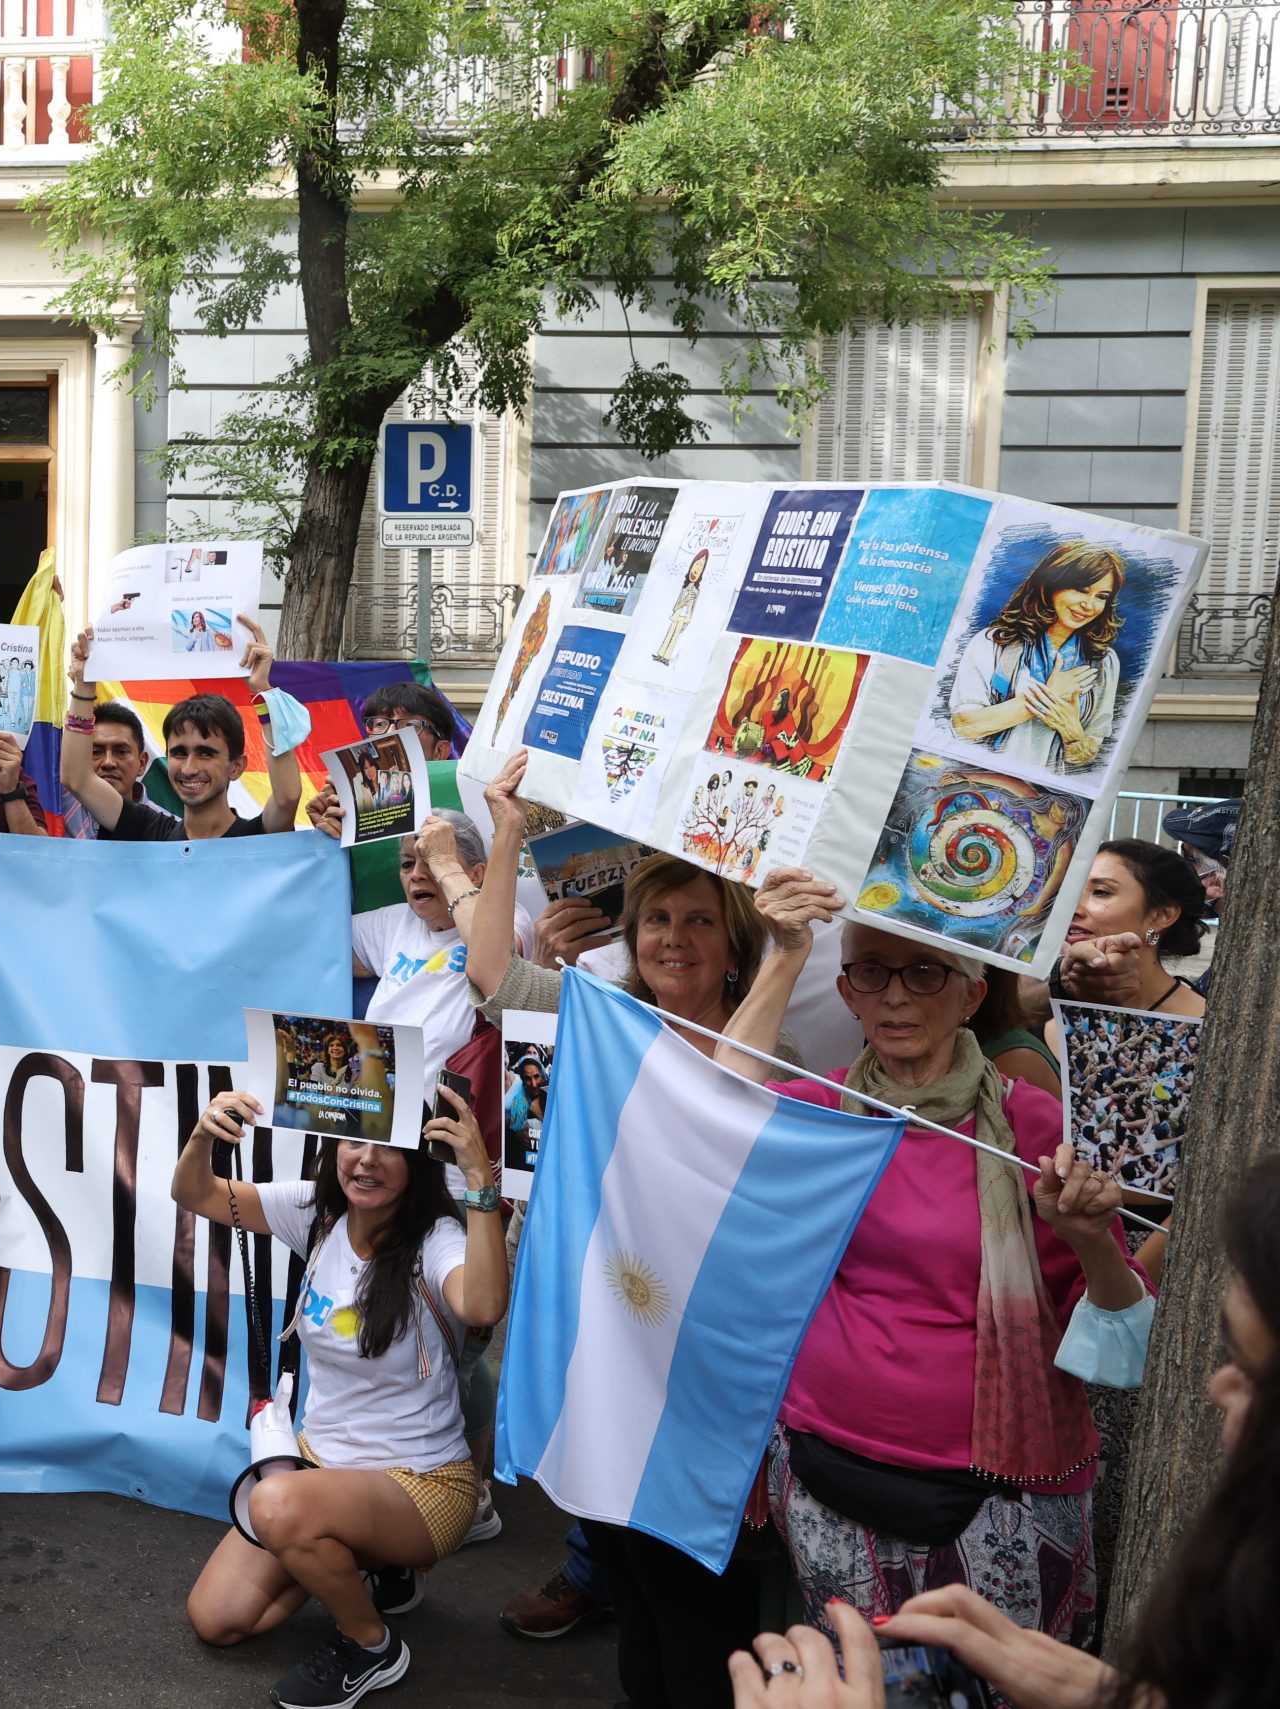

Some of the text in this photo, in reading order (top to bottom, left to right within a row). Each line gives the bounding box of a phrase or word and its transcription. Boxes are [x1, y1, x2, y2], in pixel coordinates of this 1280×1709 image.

[408, 431, 446, 504] P
[428, 484, 462, 497] C.D.
[646, 502, 660, 518] LA
[614, 518, 664, 538] VIOLENCIA
[771, 511, 842, 536] TODOS CON
[438, 533, 470, 541] ARGENTINA
[629, 537, 658, 553] DECIMOS
[761, 538, 830, 569] CRISTINA
[858, 540, 871, 550] Por
[872, 540, 880, 550] la
[880, 541, 893, 552] Paz
[902, 542, 950, 561] Defensa
[859, 556, 933, 575] de la Democracia
[610, 571, 635, 592] MÁS
[791, 576, 817, 584] democracia
[854, 581, 919, 599] Viernes 02/09
[846, 594, 861, 604] Colón
[895, 600, 920, 614] 18hs.
[555, 649, 601, 670] REPUDIO
[540, 689, 585, 710] CRISTINA
[613, 706, 665, 729] AMERICA
[611, 721, 656, 743] LATINA
[561, 862, 628, 898] FUERZA
[287, 1078, 383, 1099] El pueblo no olvida.
[288, 1091, 380, 1112] #TodosConCristina
